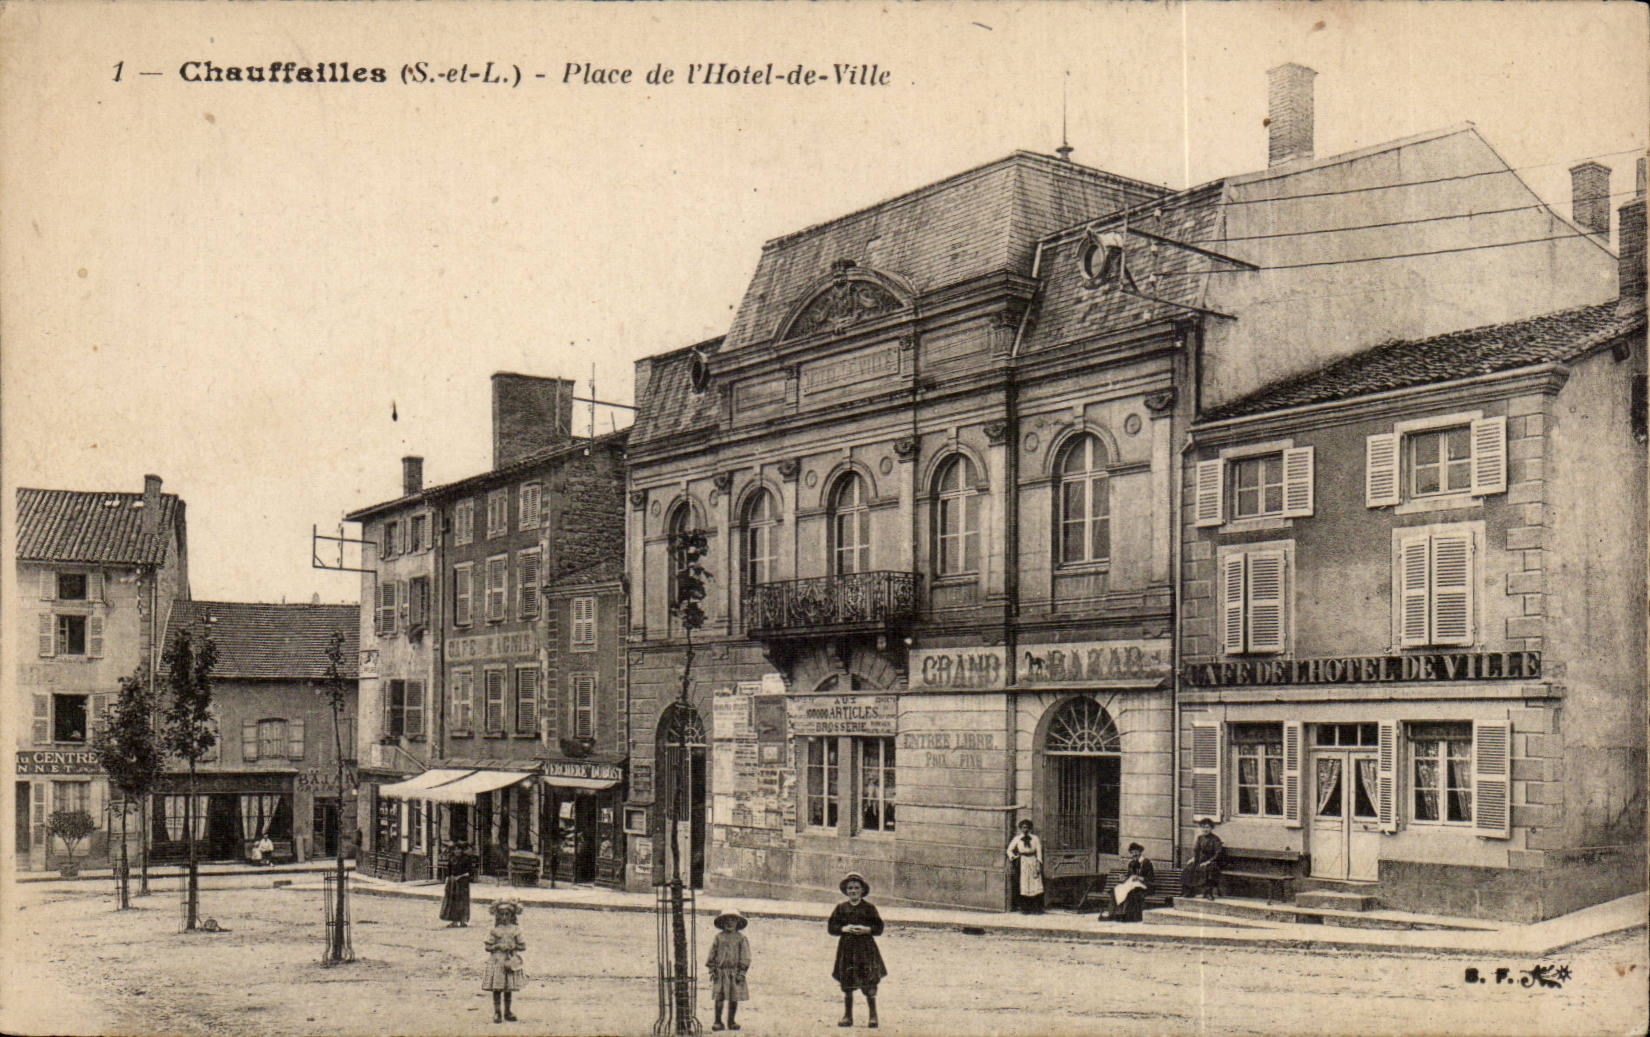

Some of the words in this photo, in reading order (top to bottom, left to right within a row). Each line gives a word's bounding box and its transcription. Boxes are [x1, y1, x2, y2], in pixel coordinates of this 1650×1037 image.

[921, 652, 1002, 689] GRAND
[1048, 645, 1145, 681] BAZAR
[1256, 661, 1285, 685] DE
[1401, 655, 1437, 681] DE
[1442, 652, 1541, 680] VILLE
[815, 721, 867, 733] BROSSERIE
[33, 752, 99, 764] CENTRE
